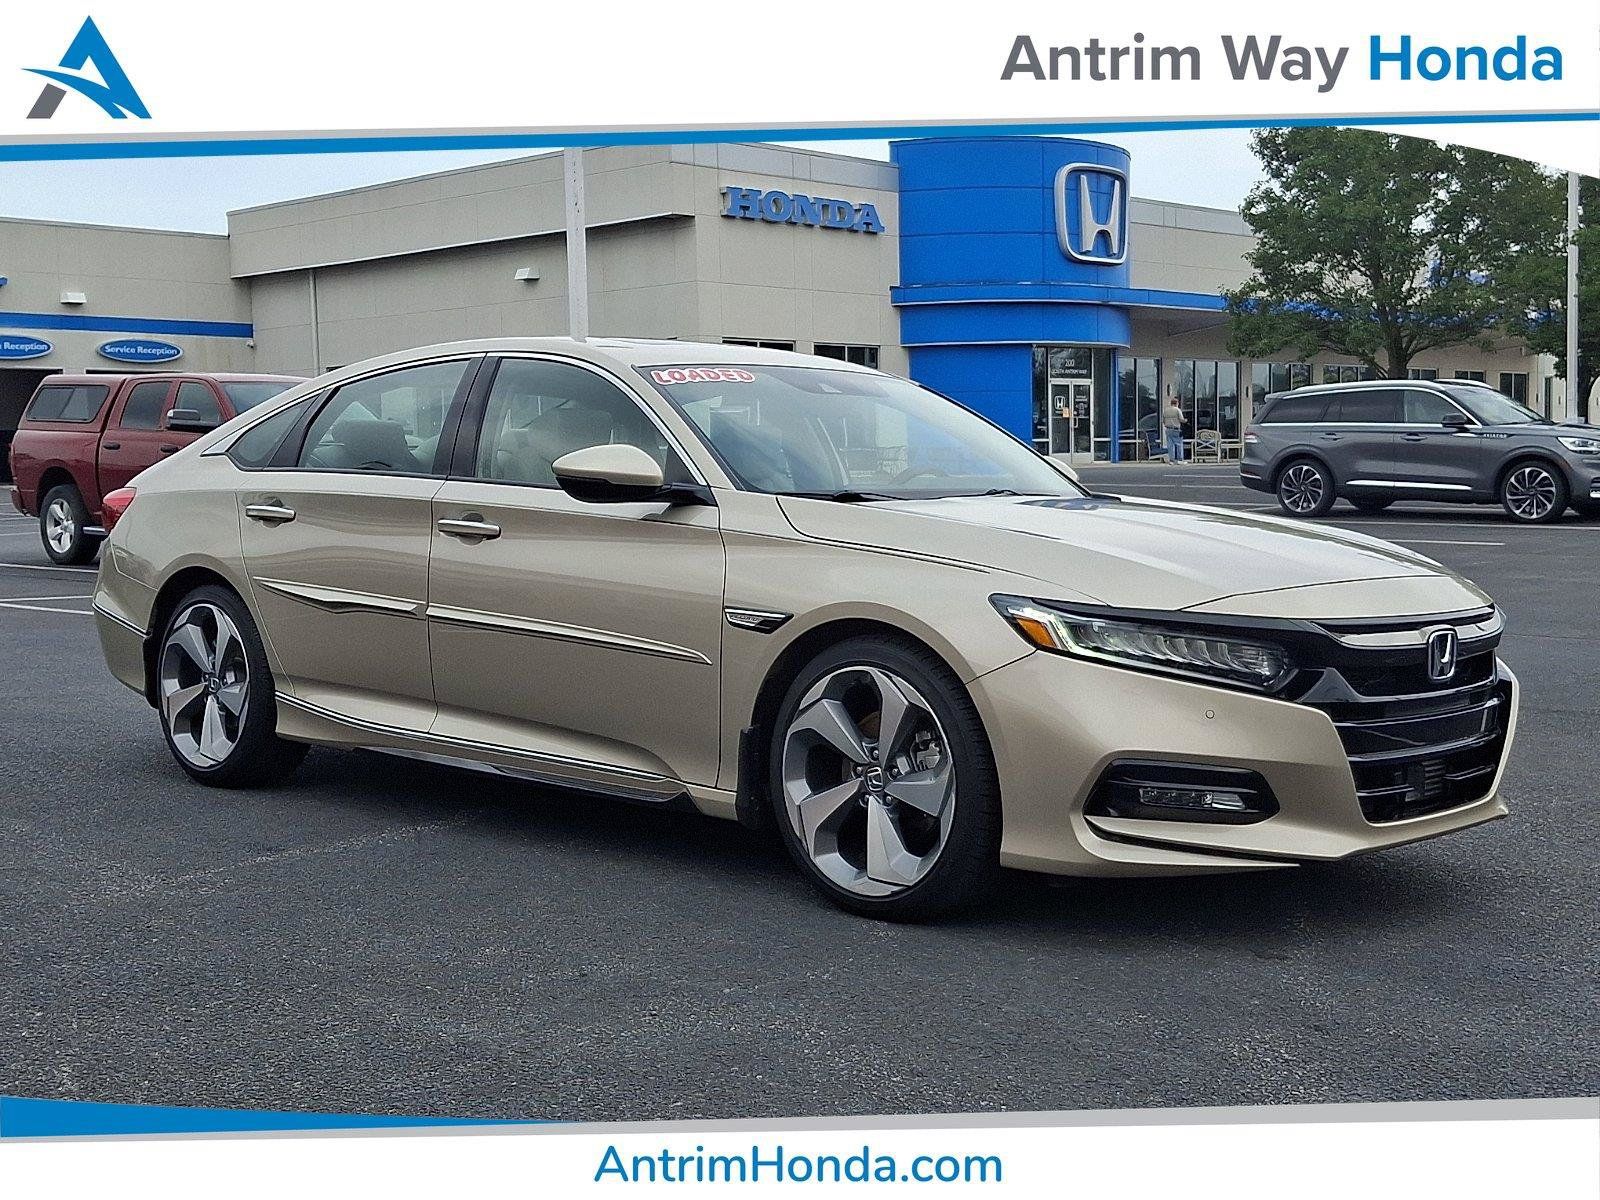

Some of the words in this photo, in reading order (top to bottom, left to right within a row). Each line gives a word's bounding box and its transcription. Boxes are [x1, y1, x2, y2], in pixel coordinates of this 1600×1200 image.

[720, 186, 886, 234] HONDA
[3, 341, 49, 352] Reception
[104, 344, 136, 354] Service
[137, 346, 178, 356] Reception
[652, 368, 755, 384] LOADED
